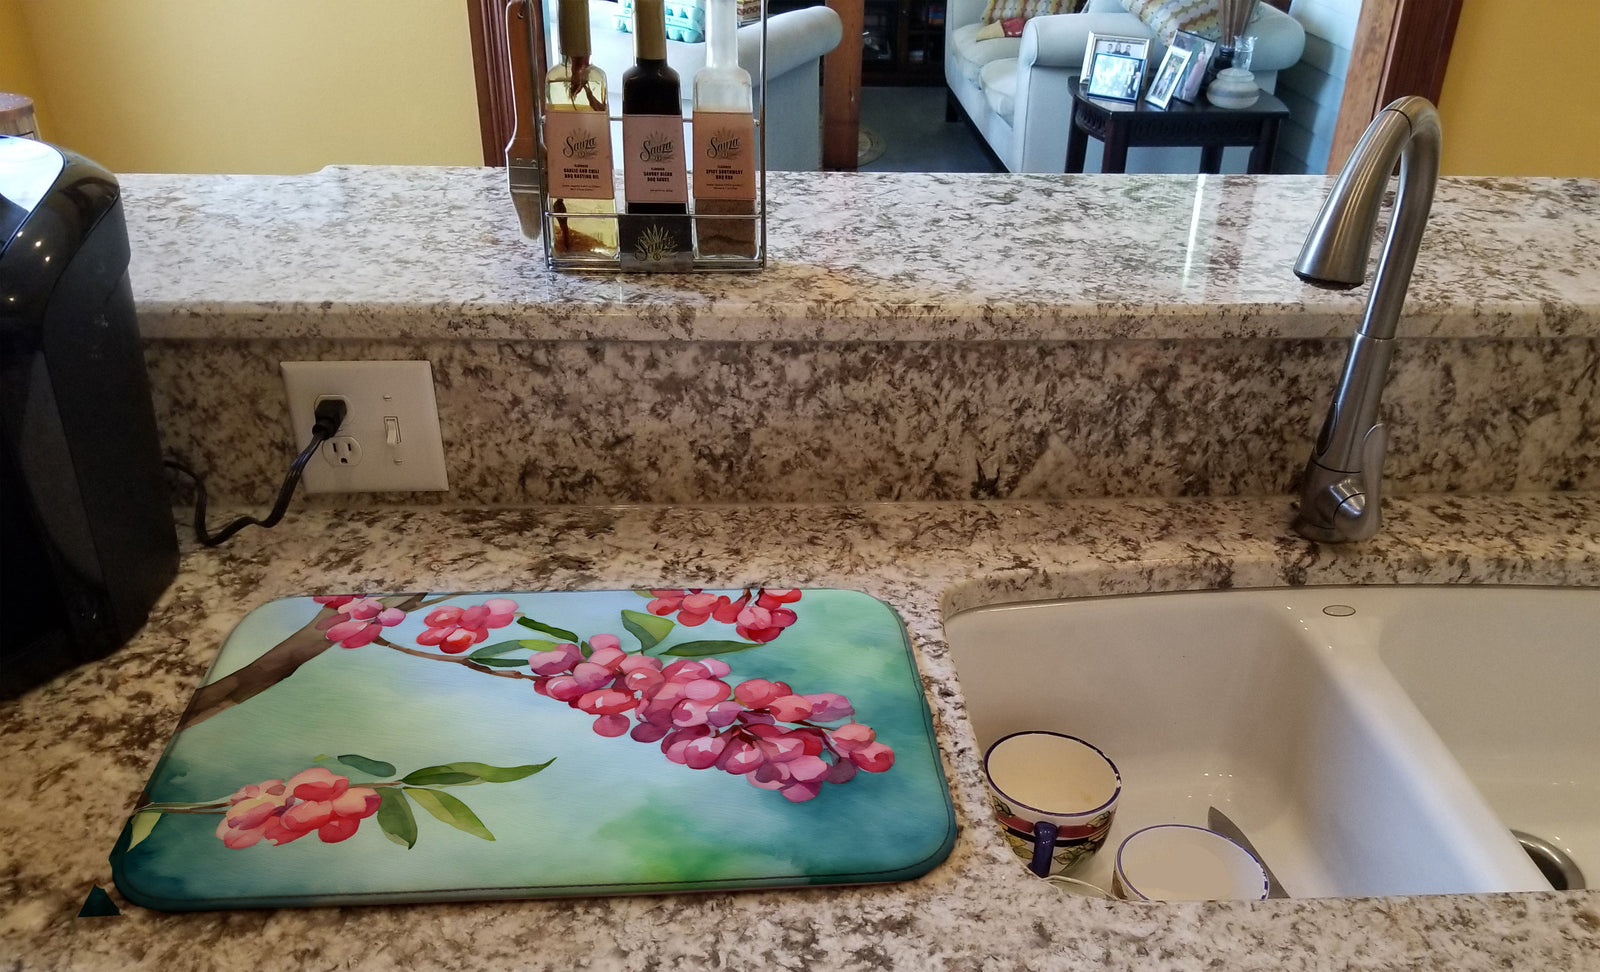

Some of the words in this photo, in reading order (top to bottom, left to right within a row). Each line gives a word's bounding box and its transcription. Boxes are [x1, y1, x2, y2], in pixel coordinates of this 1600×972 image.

[562, 136, 597, 158] Sauza
[640, 140, 673, 161] Sauza
[706, 136, 740, 159] Sauza
